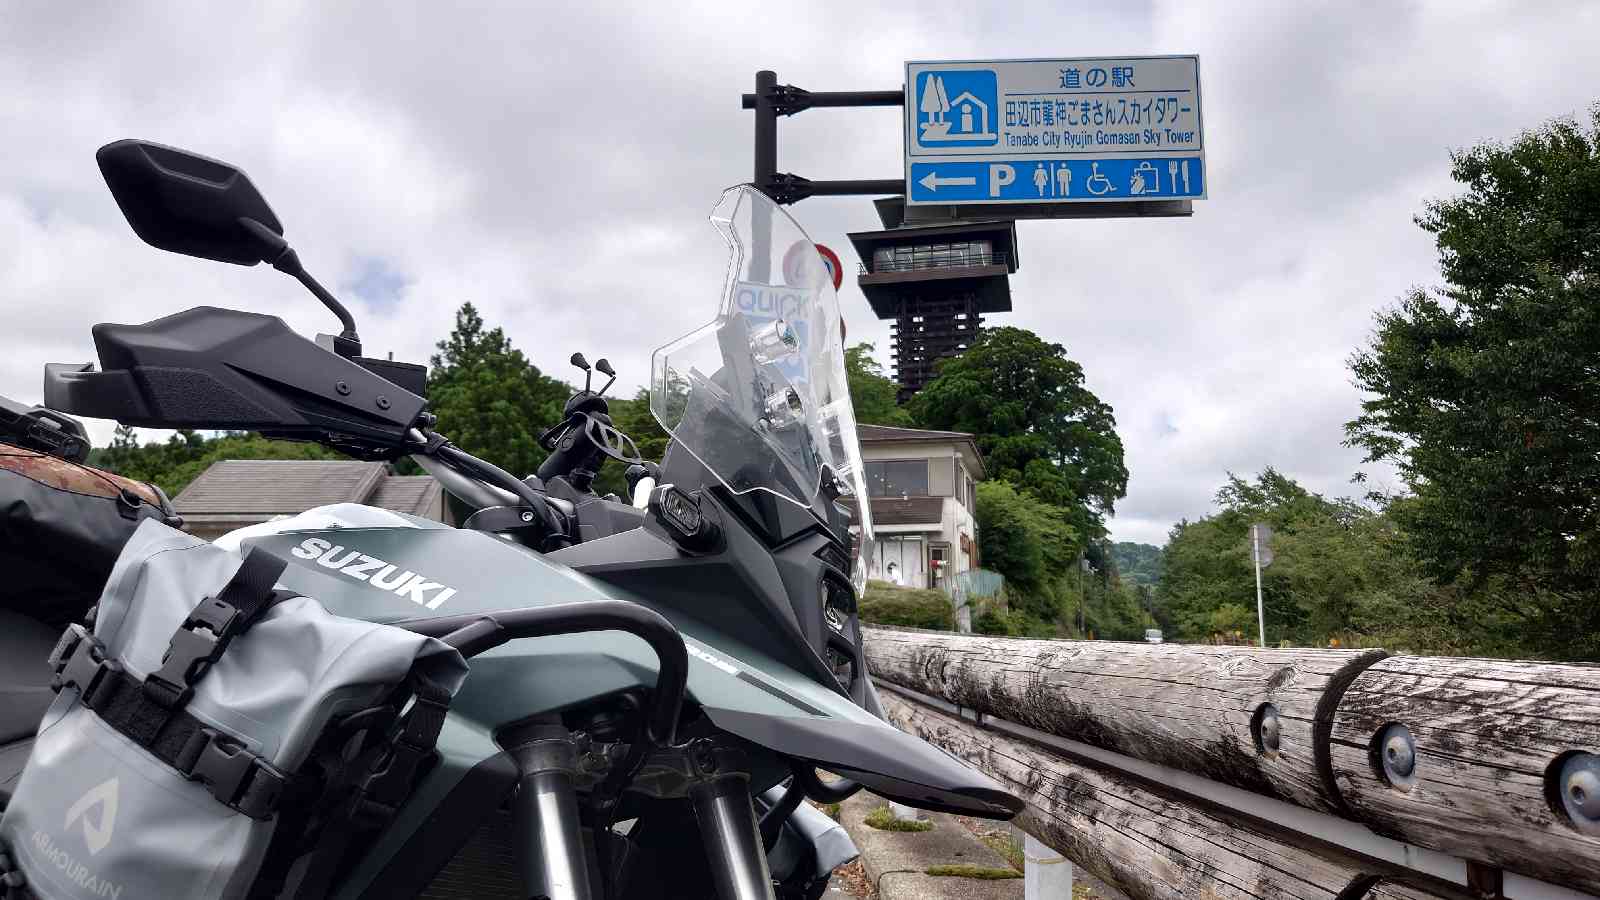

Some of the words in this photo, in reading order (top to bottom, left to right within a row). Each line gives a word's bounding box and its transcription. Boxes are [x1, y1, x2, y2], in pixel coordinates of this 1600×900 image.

[1058, 66, 1136, 89] 道の駅
[1005, 97, 1192, 128] 田辺市龍神ごまさんスカイタワー
[1004, 132, 1039, 147] Tanabe
[1042, 132, 1061, 149] City
[1064, 131, 1093, 148] Ryujin
[1096, 130, 1140, 145] Gomasan
[1143, 129, 1161, 146] Sky
[1166, 128, 1194, 144] Tower
[989, 163, 1017, 197] P
[291, 537, 458, 610] SUZUKI
[31, 830, 123, 899] ARMOURAIN
